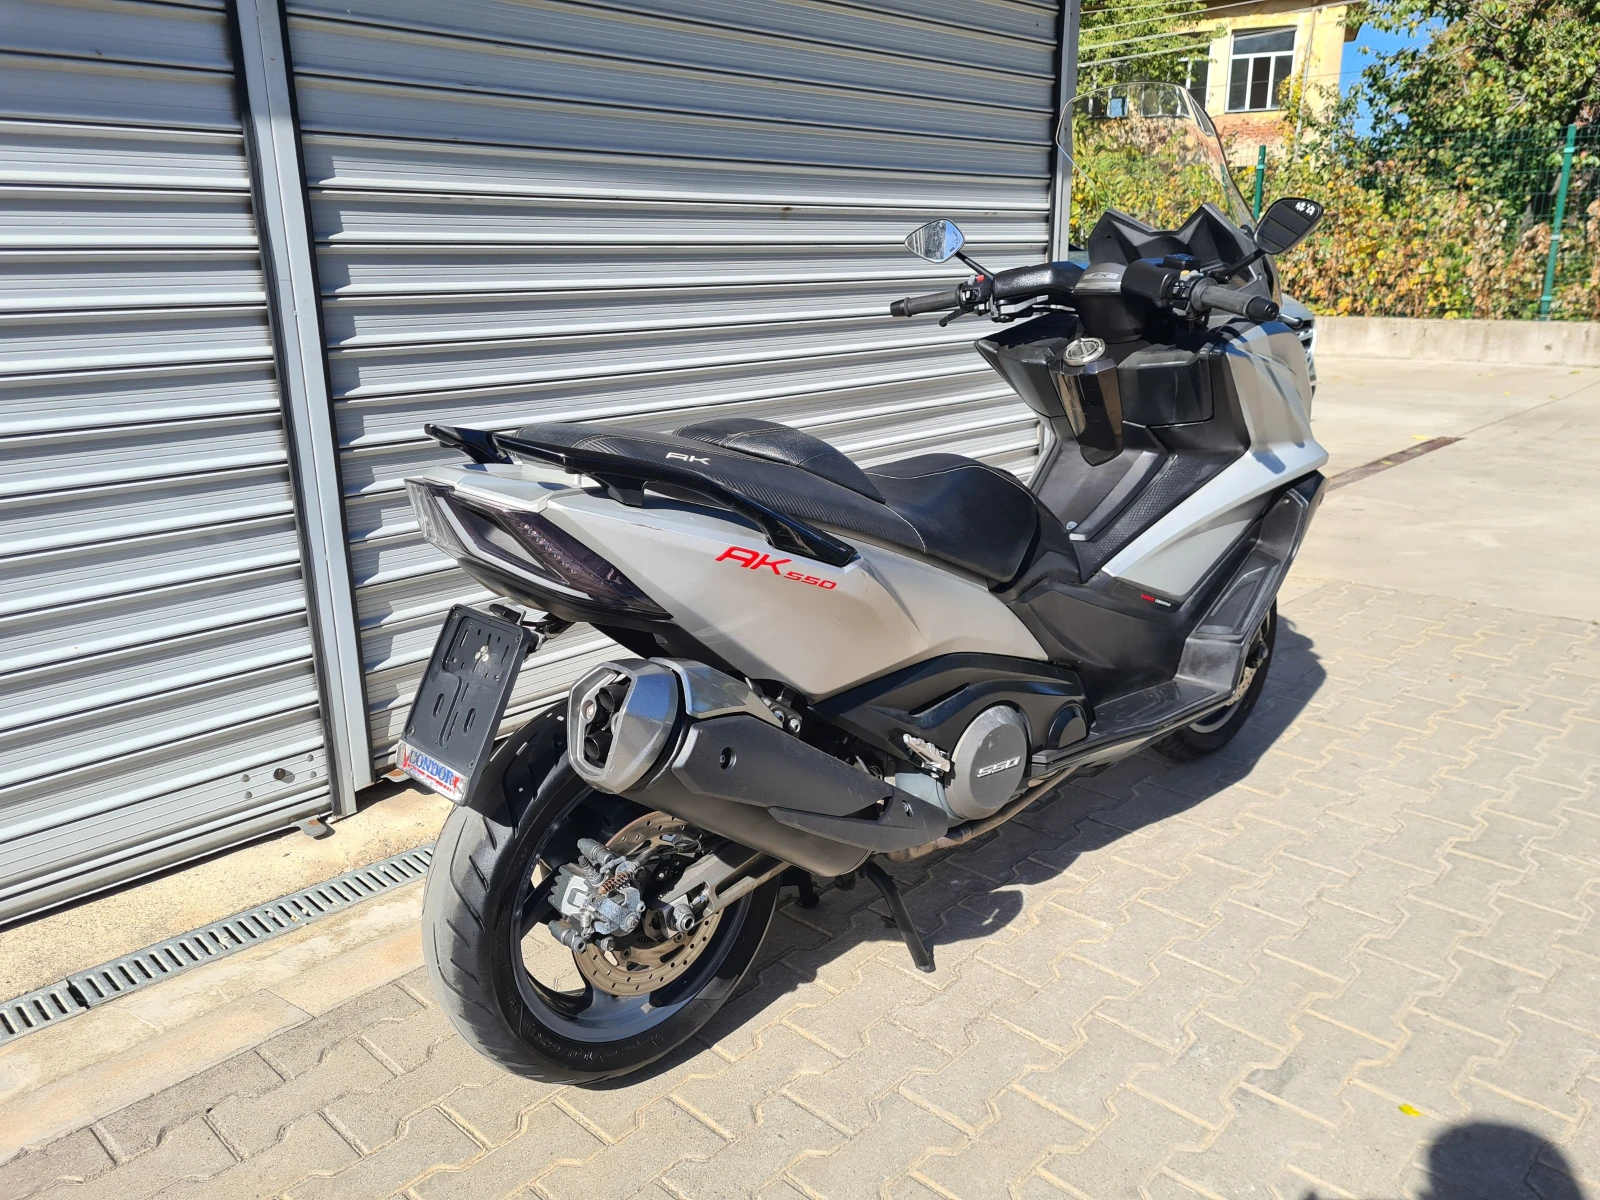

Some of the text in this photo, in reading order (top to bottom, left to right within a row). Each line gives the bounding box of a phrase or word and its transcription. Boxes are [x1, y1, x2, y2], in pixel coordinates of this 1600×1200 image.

[665, 451, 711, 465] AK
[715, 546, 837, 590] AK 550
[409, 749, 455, 786] CONDOR
[976, 756, 1021, 778] 550
